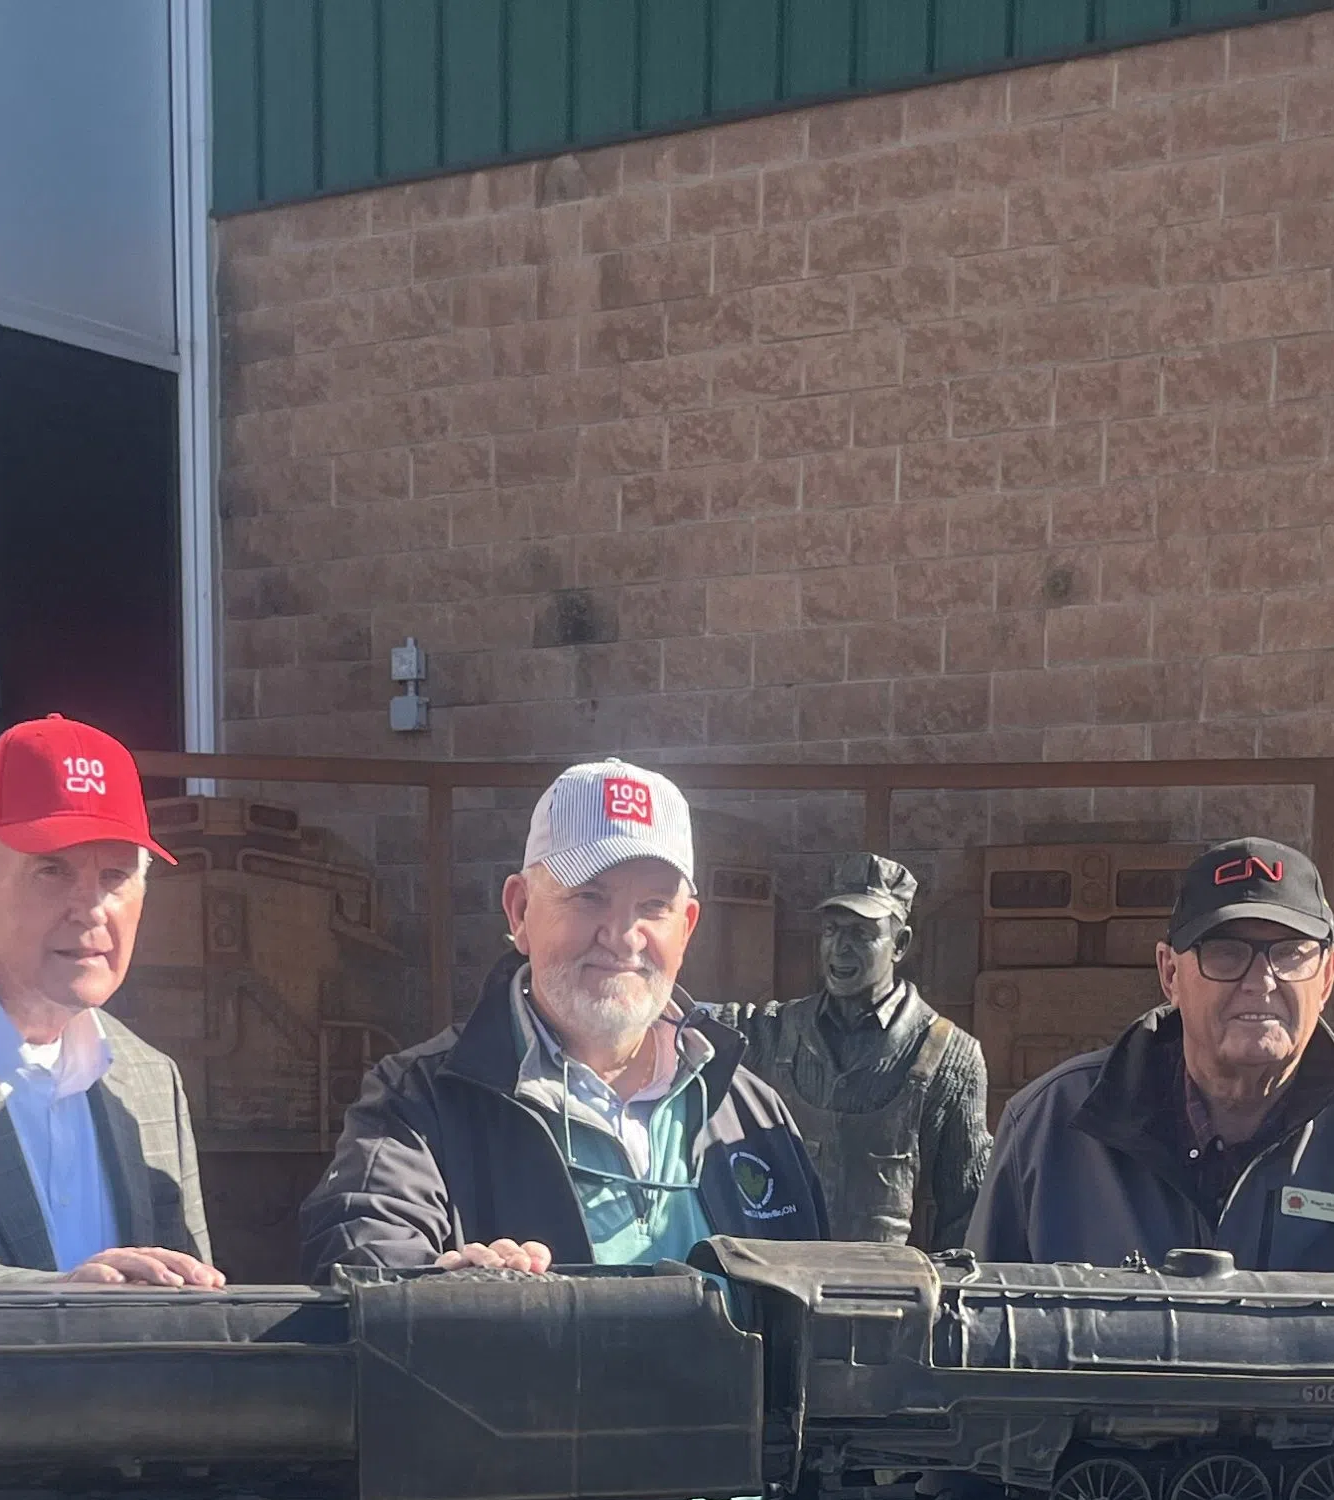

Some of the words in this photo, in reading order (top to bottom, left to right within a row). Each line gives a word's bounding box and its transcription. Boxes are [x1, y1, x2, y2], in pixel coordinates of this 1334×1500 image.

[63, 757, 105, 778] 100
[66, 777, 106, 795] CN
[609, 784, 647, 803] 100
[611, 801, 647, 818] CN
[1214, 856, 1284, 885] CN
